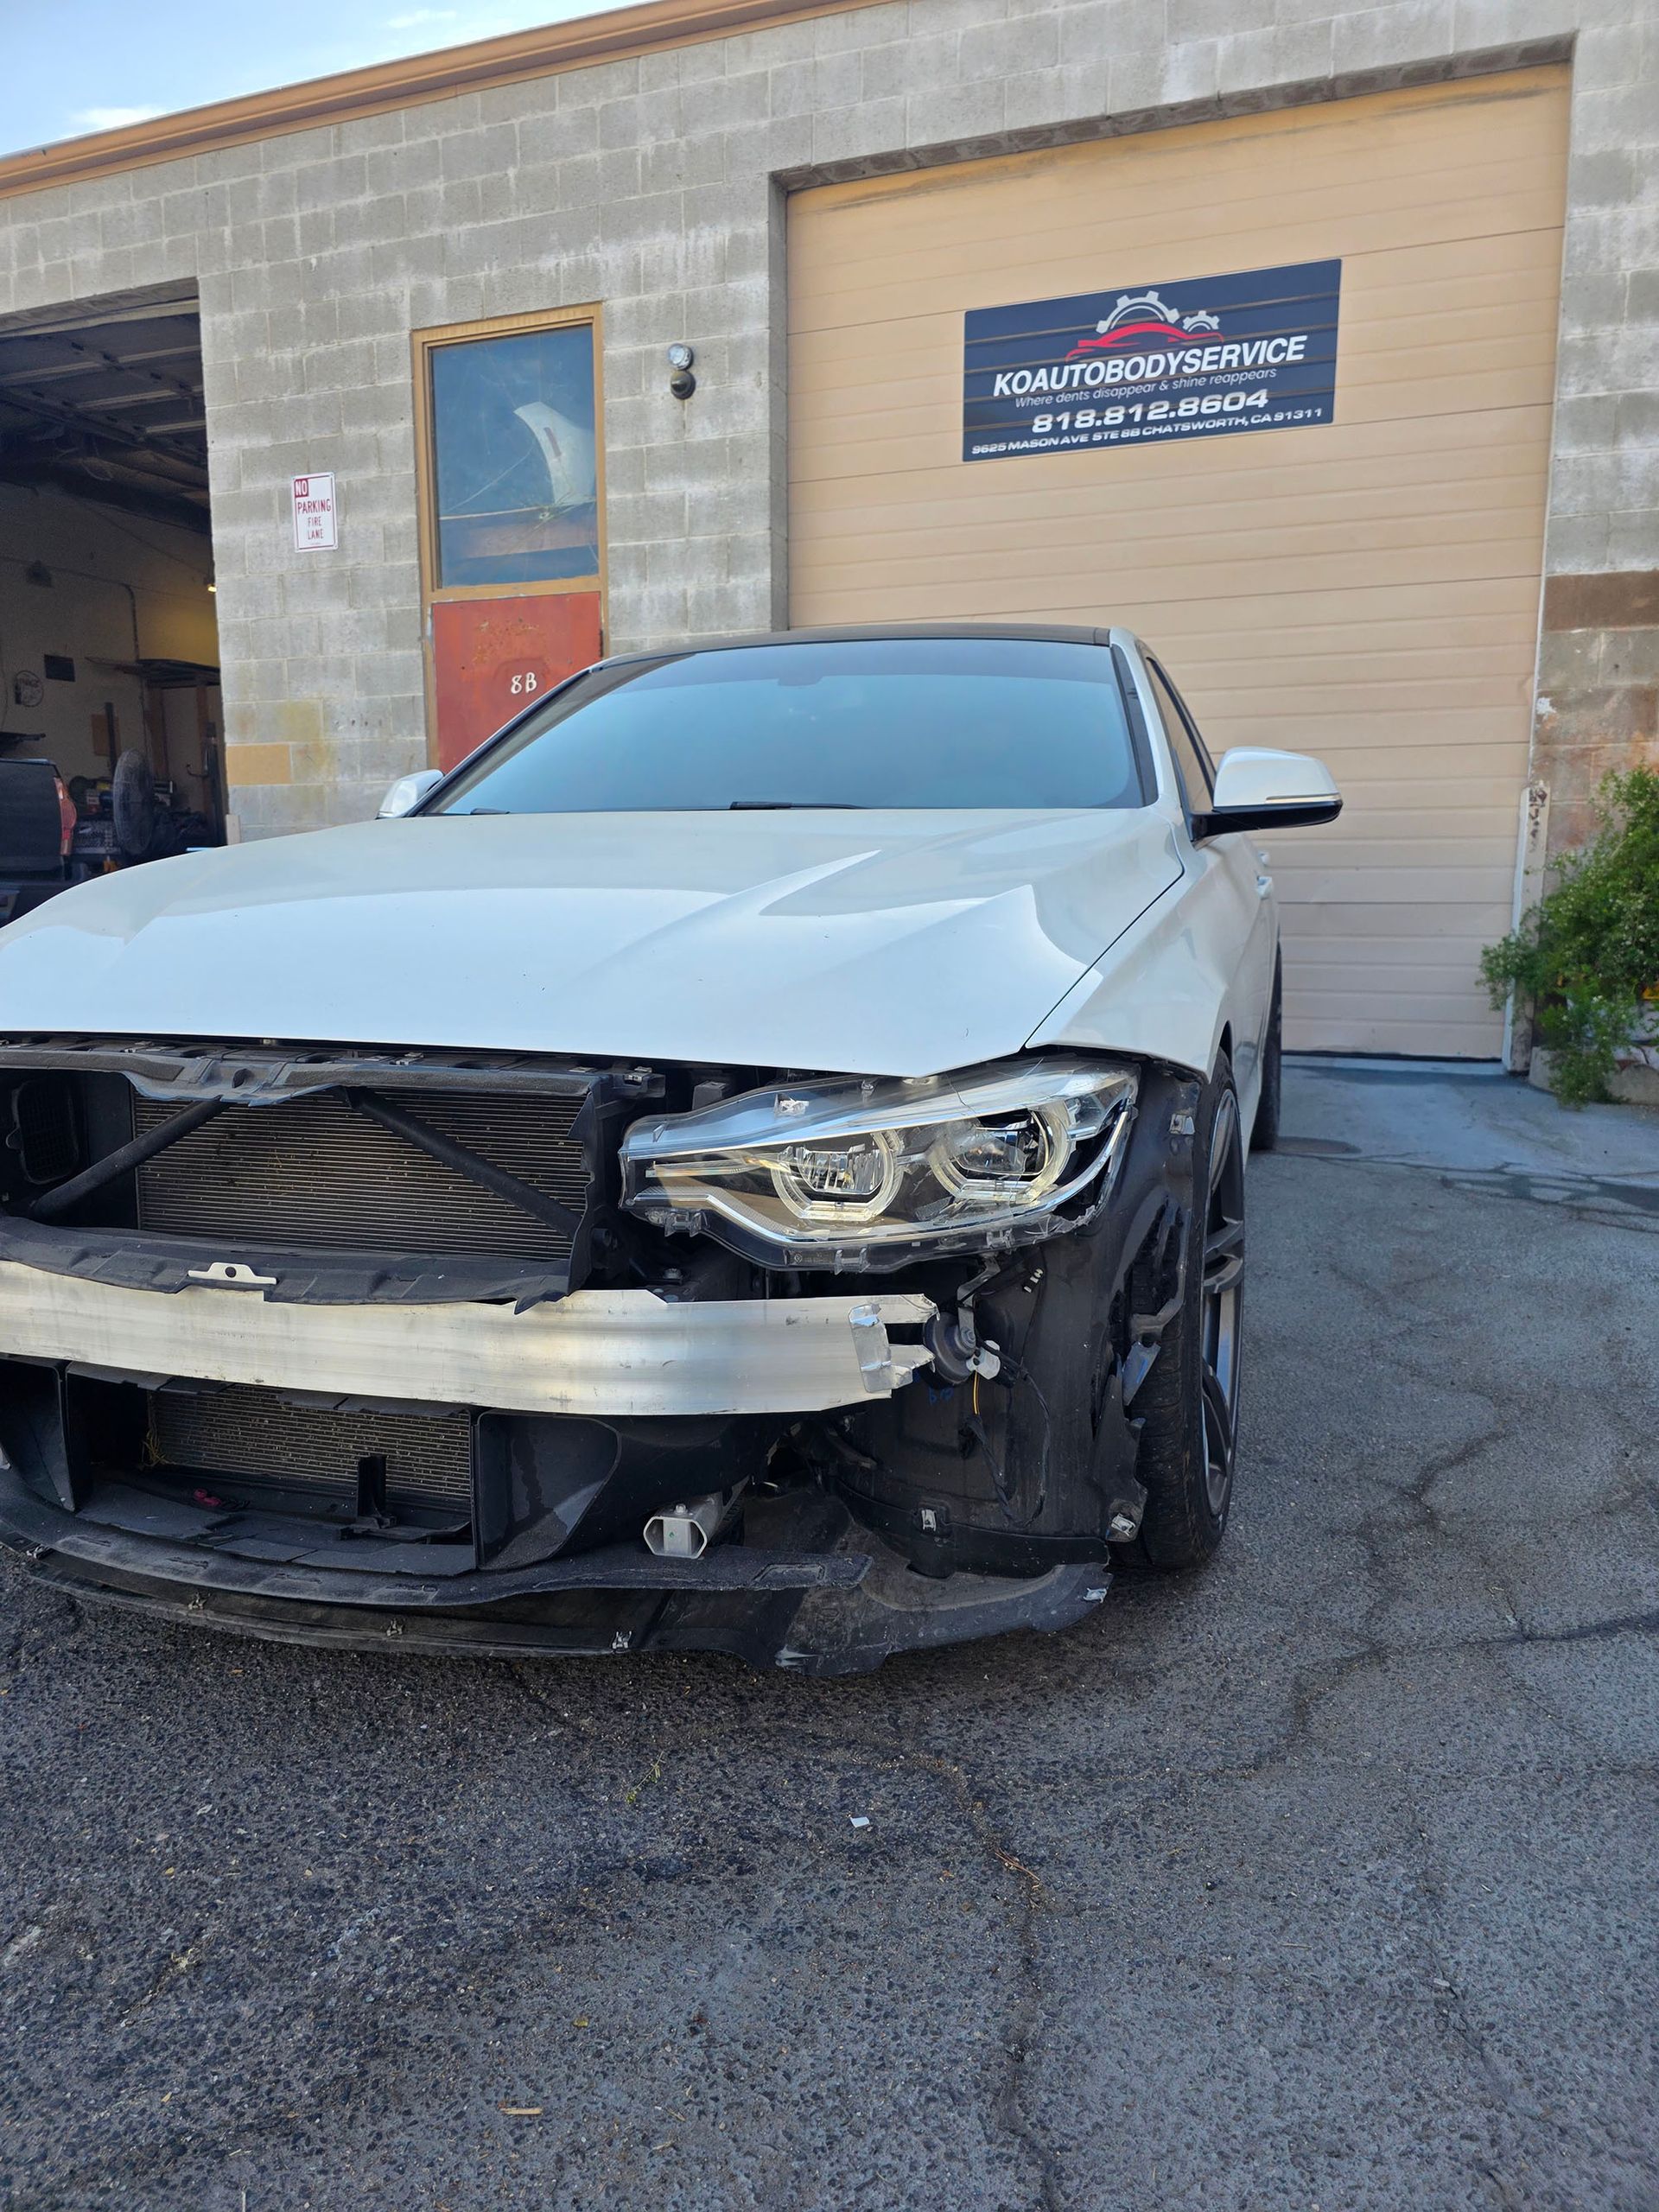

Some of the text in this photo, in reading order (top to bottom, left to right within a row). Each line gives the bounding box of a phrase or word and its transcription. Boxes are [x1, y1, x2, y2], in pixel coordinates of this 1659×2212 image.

[994, 335, 1307, 397] KOAUTOBODYSERVICE
[1015, 368, 1277, 409] Where dents disappear & shine reappears
[1032, 389, 1269, 433] 818.812.8604
[971, 442, 1008, 454] 9625
[1007, 437, 1059, 451] MASON
[1059, 433, 1090, 446] AVE
[1092, 429, 1120, 442] STE
[1141, 416, 1249, 435] CHATSWORTH,
[1250, 413, 1273, 424] CA
[1274, 408, 1323, 420] 91311
[295, 480, 308, 496] NO
[297, 499, 332, 514] PARKING
[308, 516, 321, 527] FIRE
[308, 529, 324, 540] LANE
[511, 671, 537, 695] 8B
